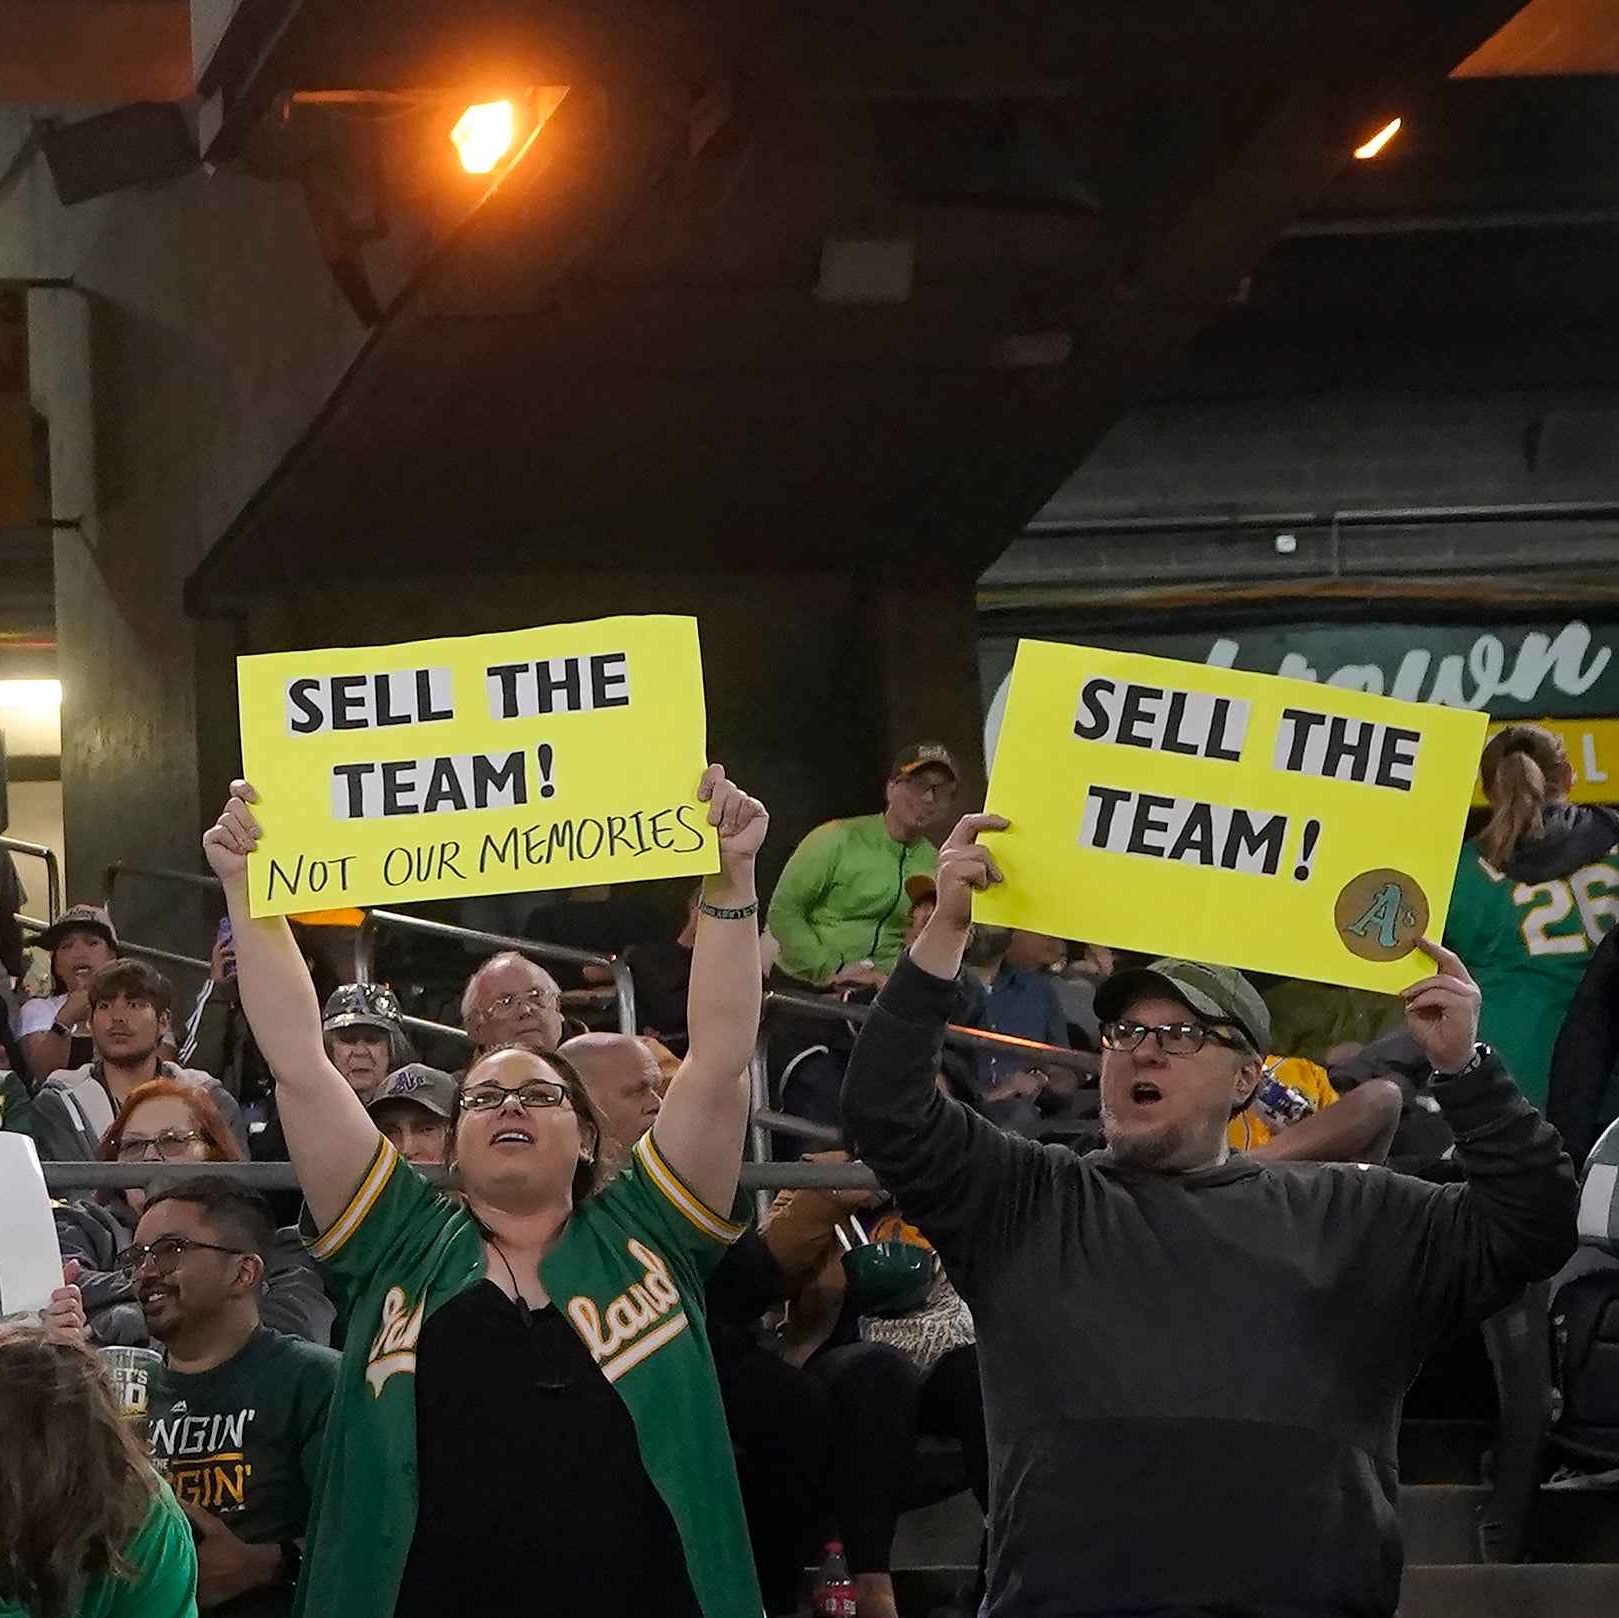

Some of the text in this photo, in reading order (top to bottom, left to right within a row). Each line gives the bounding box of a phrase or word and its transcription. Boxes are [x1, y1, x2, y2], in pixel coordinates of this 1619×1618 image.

[288, 652, 629, 733] SELL THE
[1074, 678, 1243, 762] SELL
[1282, 708, 1421, 792] THE
[333, 743, 555, 818] TEAM!
[267, 806, 705, 900] NOT OUR MEMORIES
[1087, 785, 1322, 883] TEAM!
[1513, 863, 1619, 956] 26
